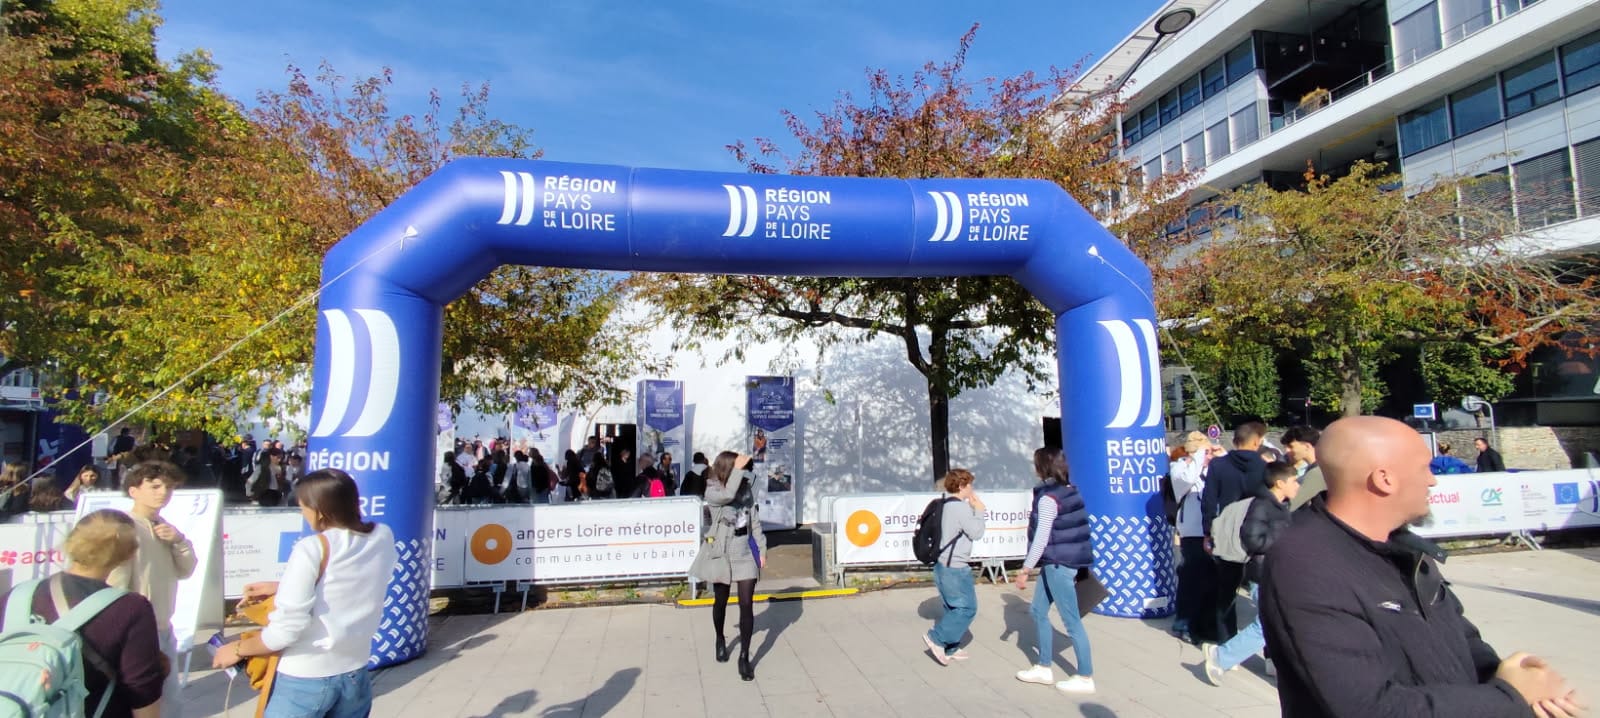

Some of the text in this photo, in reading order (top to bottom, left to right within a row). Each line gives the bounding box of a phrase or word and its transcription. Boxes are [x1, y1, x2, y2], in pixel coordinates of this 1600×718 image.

[544, 175, 616, 193] RÉGION
[543, 192, 592, 211] PAYS
[765, 187, 831, 204] RÉGION
[967, 192, 1029, 206] RÉGION
[543, 210, 556, 219] DE
[543, 211, 616, 231] LA LOIRE
[766, 204, 810, 221] PAYS
[969, 208, 1011, 224] PAYS
[782, 222, 831, 240] LOIRE
[983, 225, 1030, 241] LOIRE
[309, 448, 390, 471] RÉGION
[1108, 457, 1156, 475] PAYS
[1110, 476, 1123, 485] DE
[1110, 475, 1163, 494] LA LOI
[983, 508, 1032, 524] étropole
[516, 527, 572, 542] angers
[618, 521, 695, 538] métropole
[983, 535, 1026, 544] urbain
[515, 549, 695, 566] communauté urbaine
